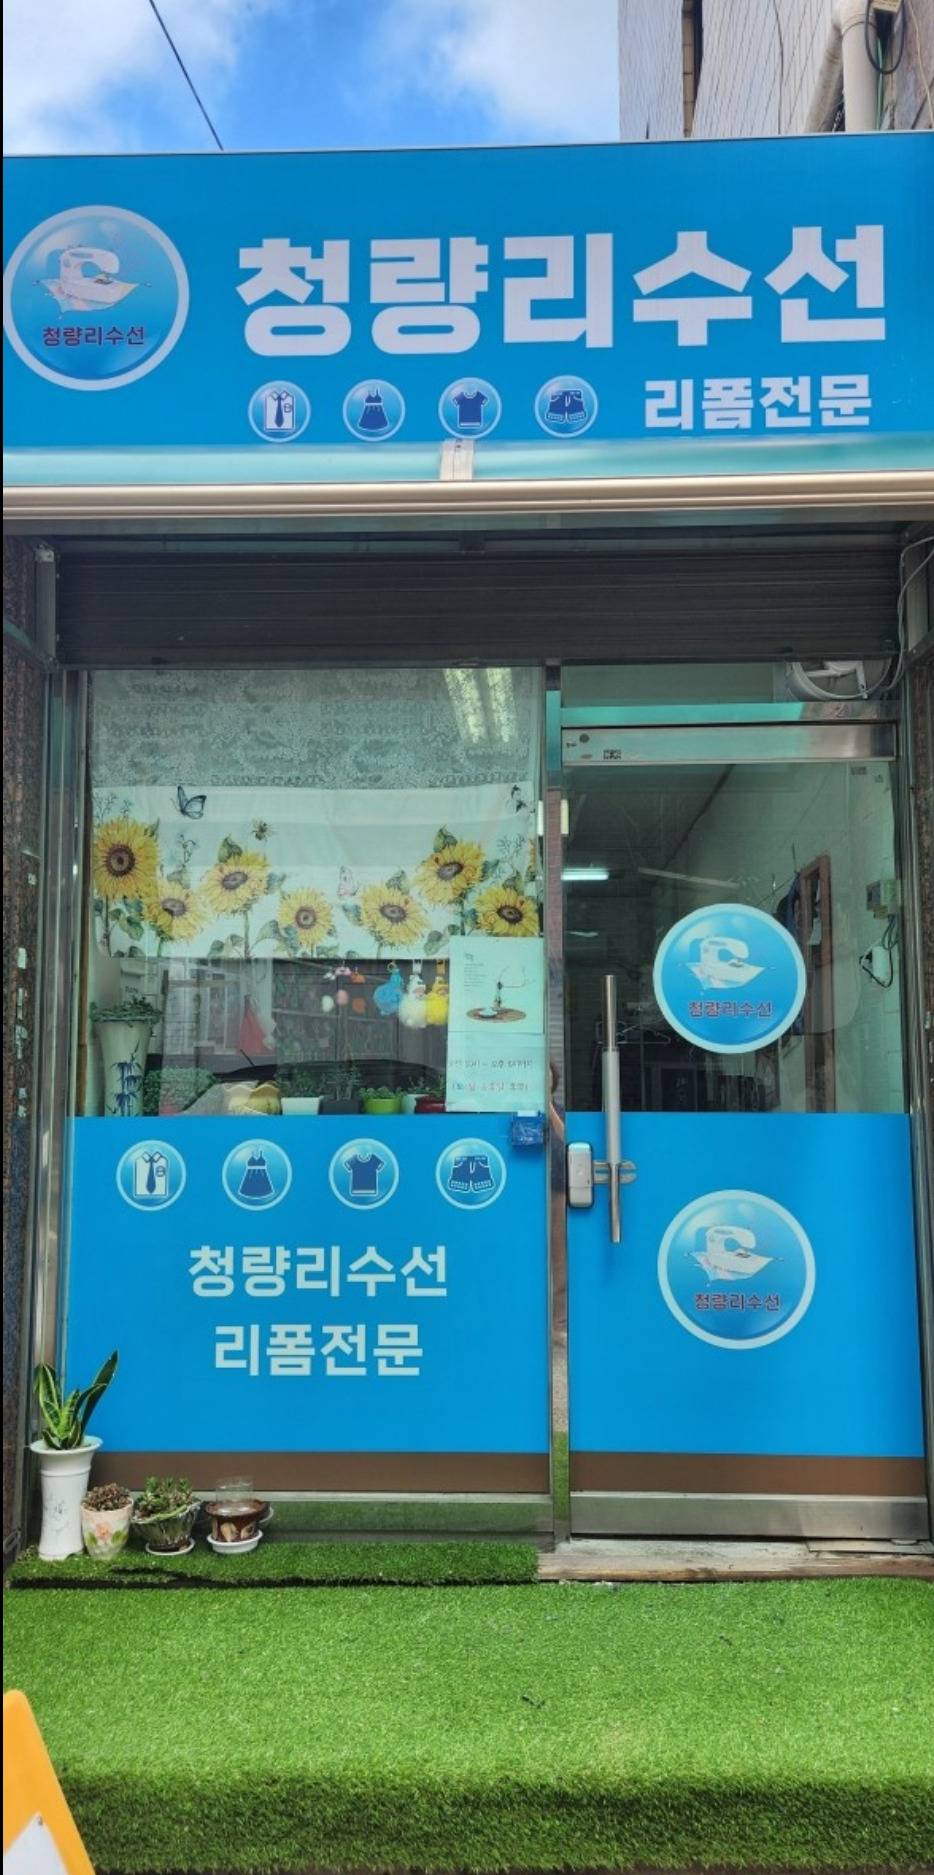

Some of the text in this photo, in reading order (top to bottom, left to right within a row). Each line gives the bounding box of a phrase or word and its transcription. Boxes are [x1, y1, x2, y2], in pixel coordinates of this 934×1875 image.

[236, 224, 886, 356] 청량리수선
[42, 326, 145, 347] 청량리수선
[645, 374, 872, 430] 리폼전문
[689, 1001, 773, 1018] 청량리수선
[188, 1245, 447, 1297] 청량리수선
[695, 1293, 780, 1311] 청량리수선
[215, 1324, 423, 1376] 리폼전문
